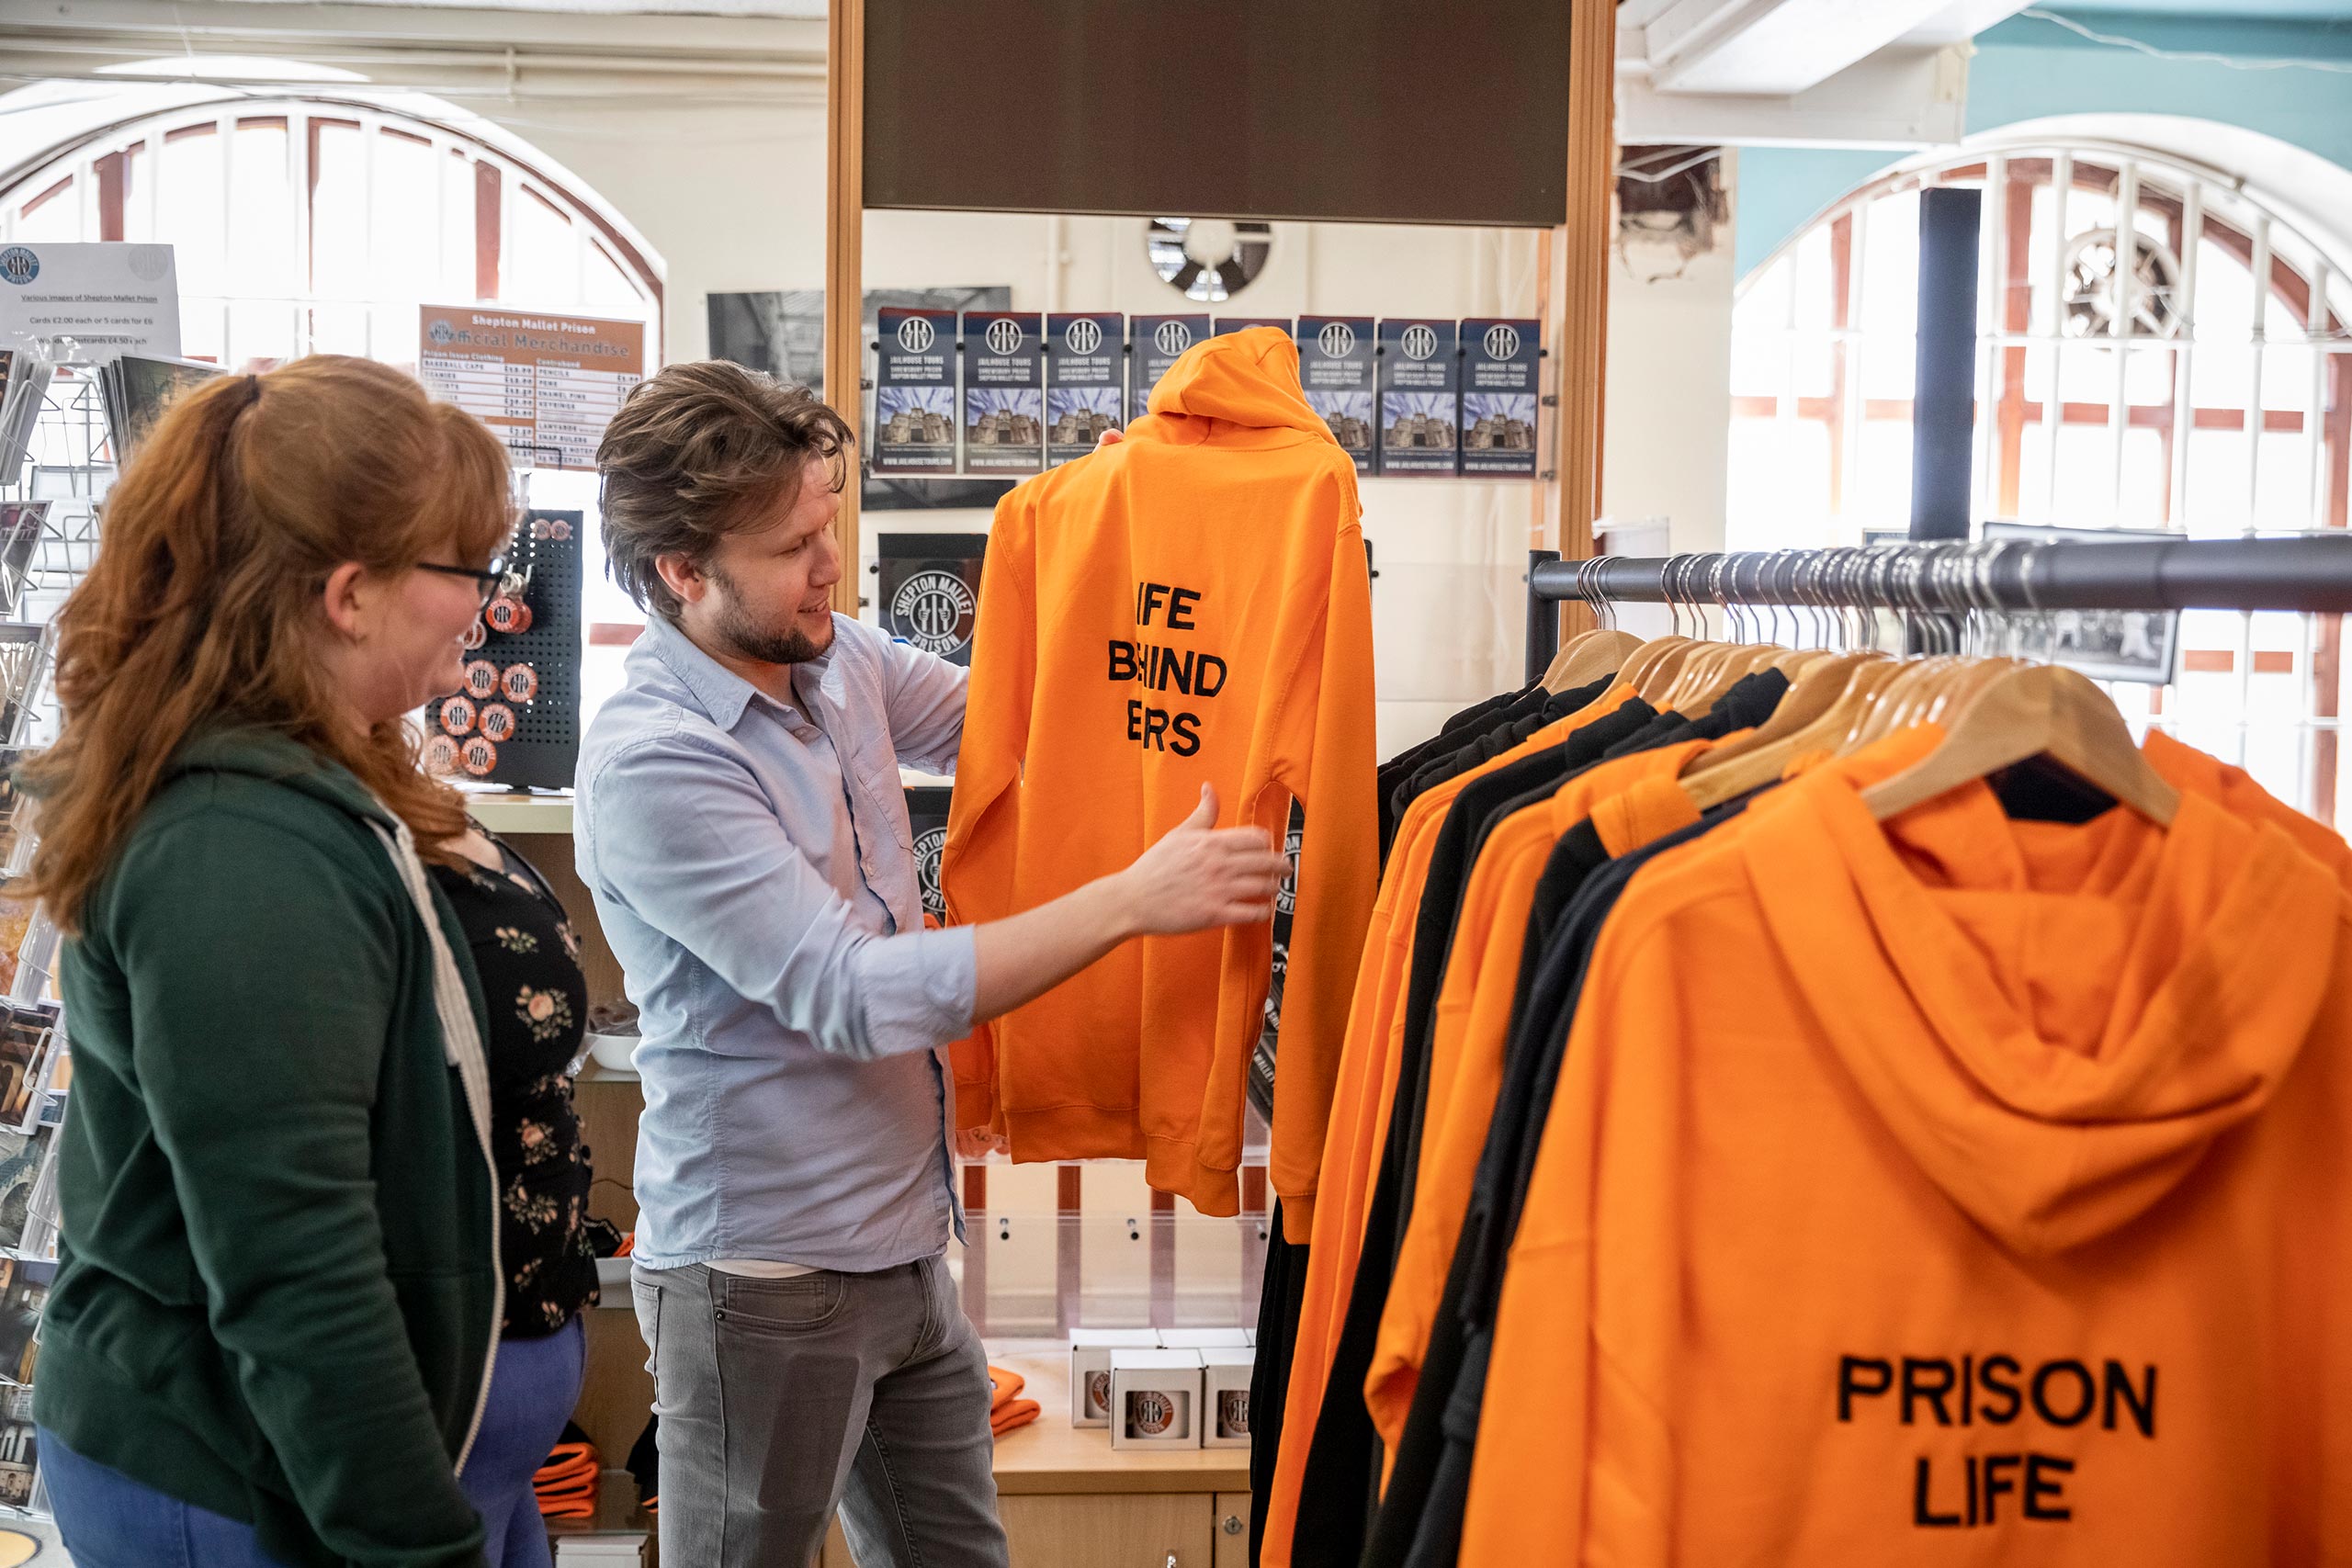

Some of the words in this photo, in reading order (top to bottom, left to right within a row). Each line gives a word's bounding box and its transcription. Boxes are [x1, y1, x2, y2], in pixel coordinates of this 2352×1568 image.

[74, 294, 83, 302] of
[84, 294, 112, 302] Shepton
[136, 295, 158, 303] Prison
[471, 314, 520, 329] Shepton
[521, 318, 559, 332] Mallet
[560, 321, 596, 334] Prison
[514, 332, 630, 357] Merchandise
[895, 575, 936, 616] SHEPTON
[937, 576, 974, 615] MALLET
[910, 633, 961, 653] PRISON
[1838, 1354, 2157, 1438] PRISON
[1914, 1452, 2075, 1528] LIFE
